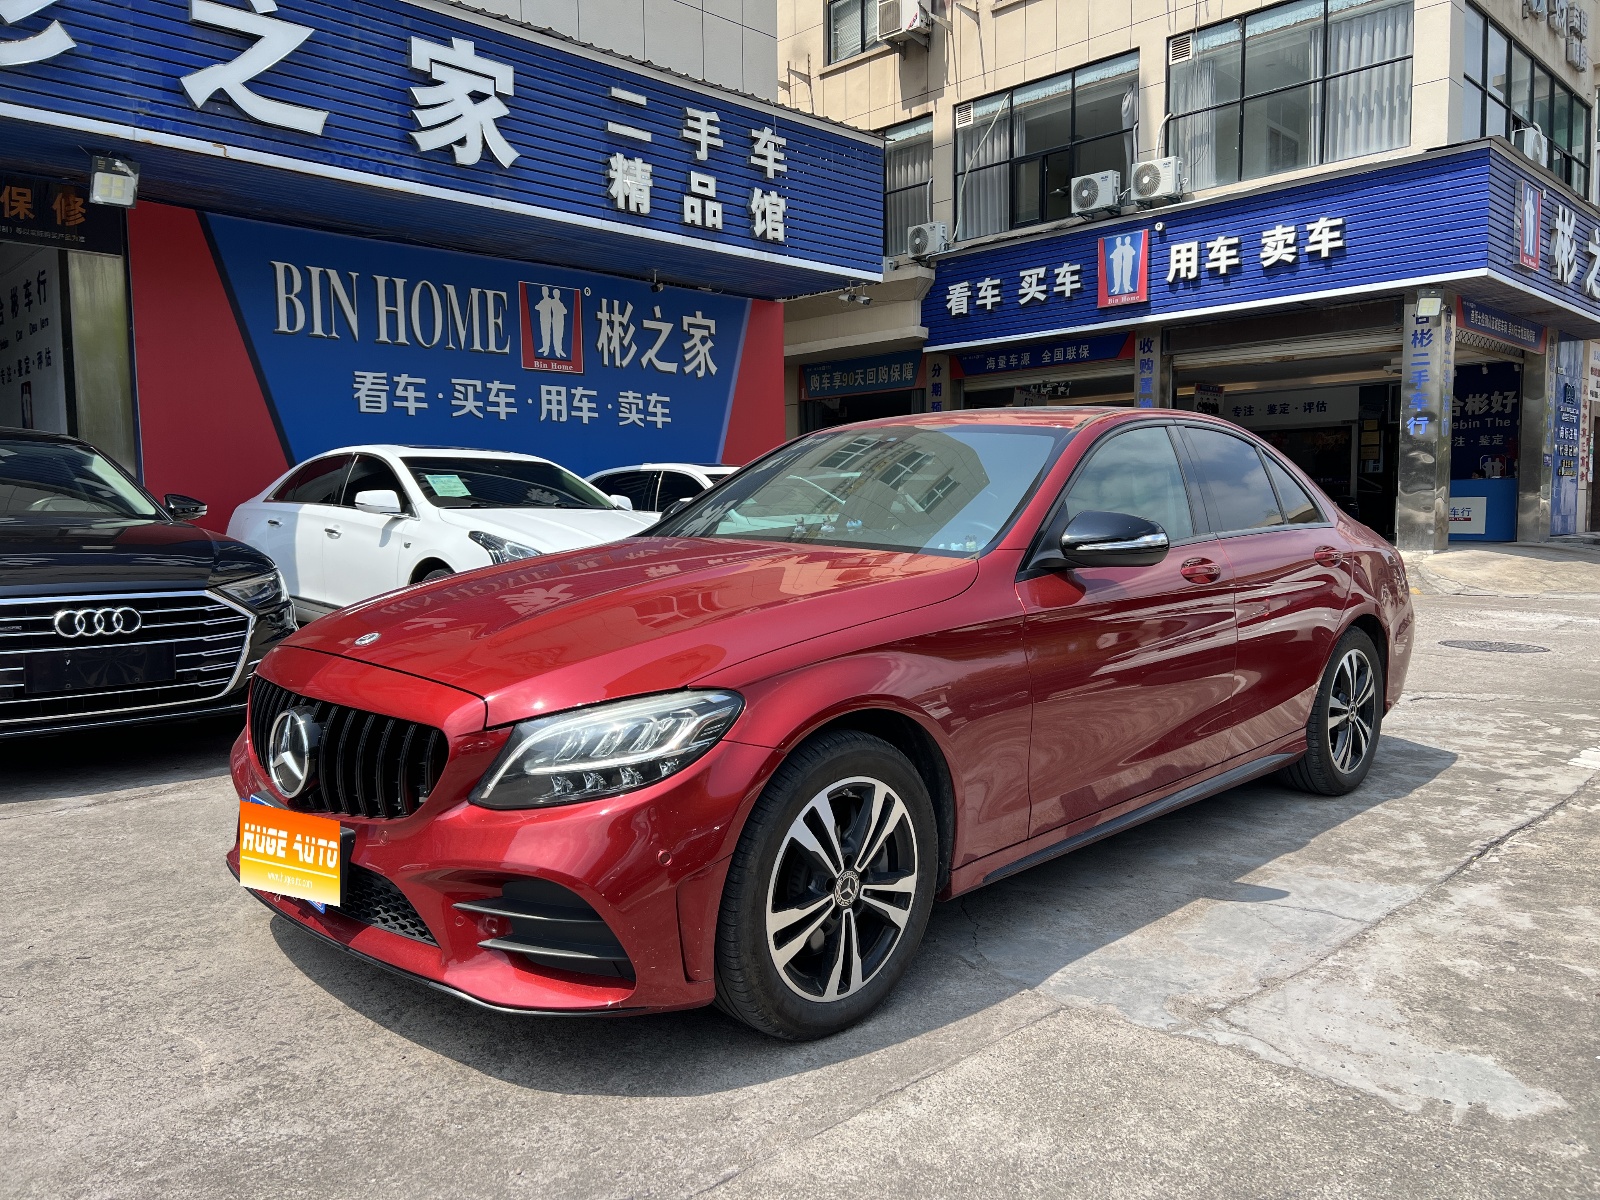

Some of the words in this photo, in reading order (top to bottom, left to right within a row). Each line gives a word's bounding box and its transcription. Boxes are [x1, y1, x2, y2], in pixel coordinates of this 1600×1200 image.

[605, 87, 788, 180] 二手车
[605, 150, 786, 243] 精品馆
[1166, 235, 1241, 283] 用车
[1260, 216, 1346, 268] 卖车
[270, 259, 360, 343] BIN
[372, 274, 511, 355] HOME
[946, 277, 1002, 317] 看车
[1018, 262, 1082, 306] 买车
[1107, 297, 1119, 305] Bin
[1121, 295, 1140, 303] Home
[534, 360, 549, 370] Bin
[551, 362, 574, 372] Home
[596, 298, 719, 379] 彬之家
[985, 352, 1031, 371] 海量车源
[1041, 343, 1091, 363] 全国联保
[809, 361, 914, 392] 购车享90天回购保障
[1484, 416, 1512, 428] The
